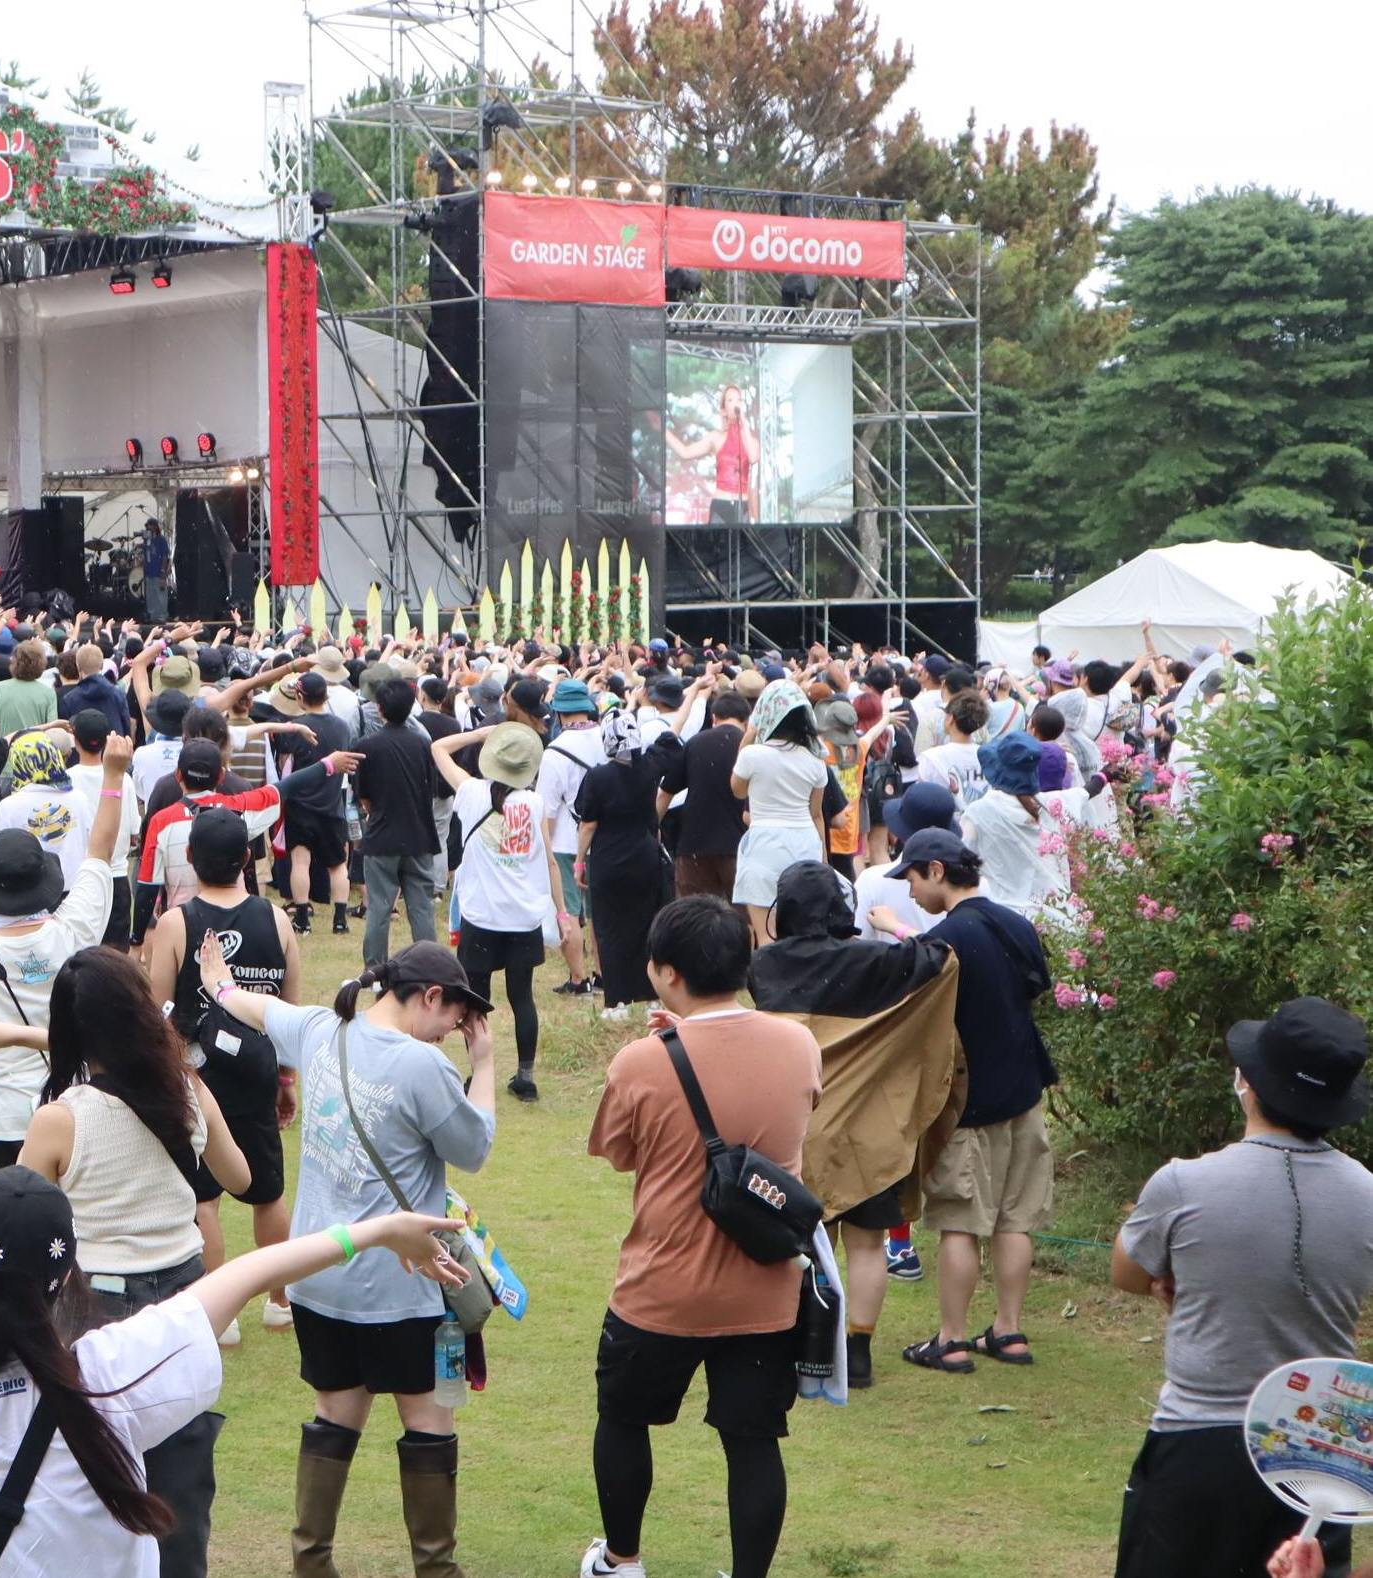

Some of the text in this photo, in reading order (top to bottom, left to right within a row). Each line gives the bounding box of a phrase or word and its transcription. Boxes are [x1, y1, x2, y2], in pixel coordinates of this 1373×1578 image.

[750, 224, 862, 266] docomo
[771, 226, 787, 236] NTT
[511, 240, 646, 270] GARDEN STAGE
